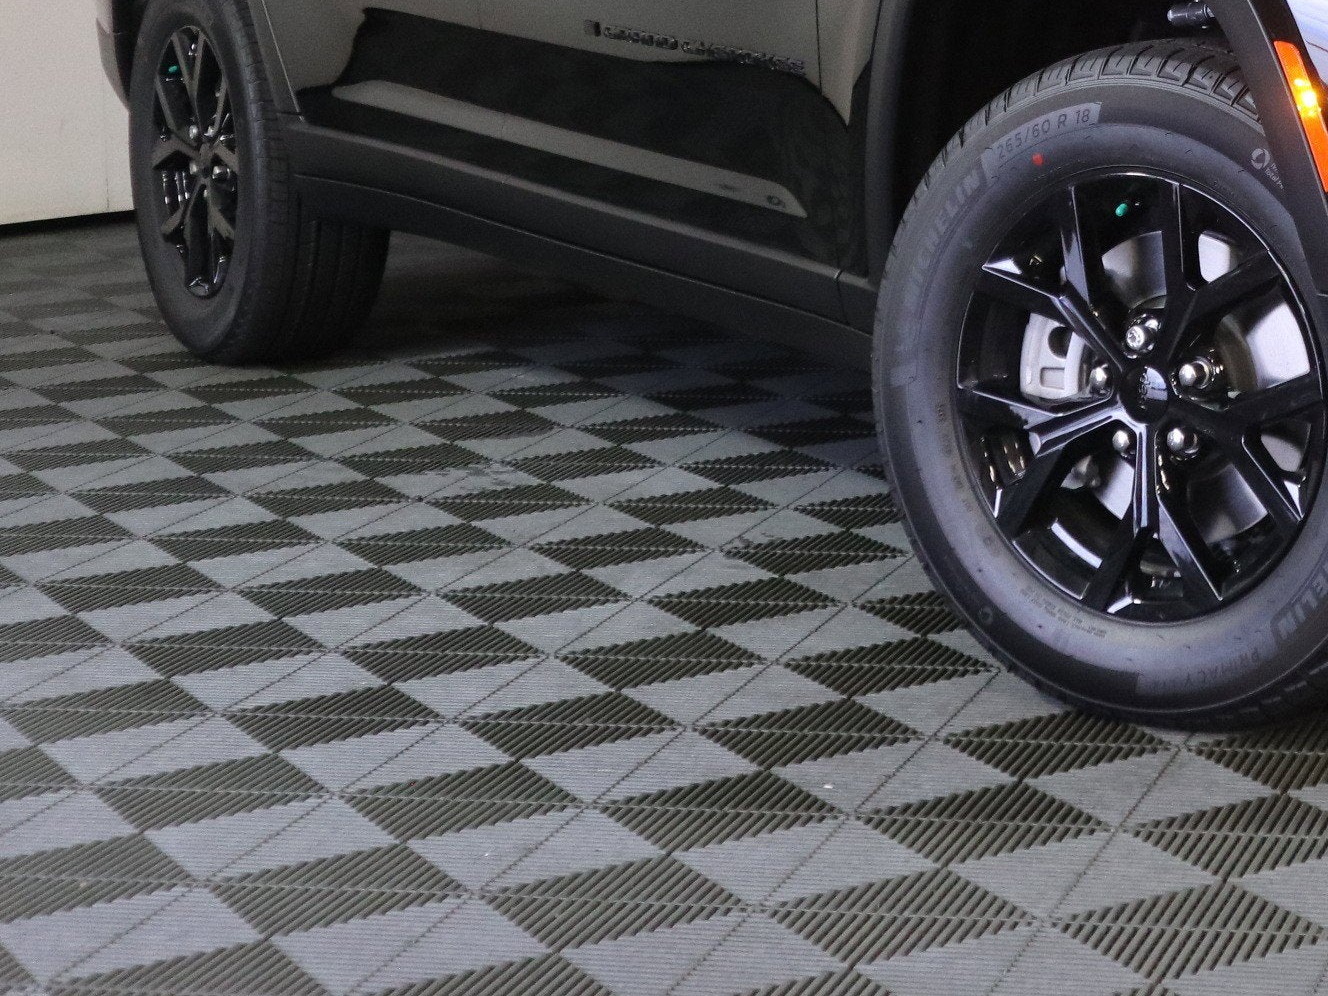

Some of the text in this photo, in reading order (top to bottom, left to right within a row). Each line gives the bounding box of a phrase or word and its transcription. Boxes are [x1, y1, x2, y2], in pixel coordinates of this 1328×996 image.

[997, 108, 1091, 160] 265/60 R 18
